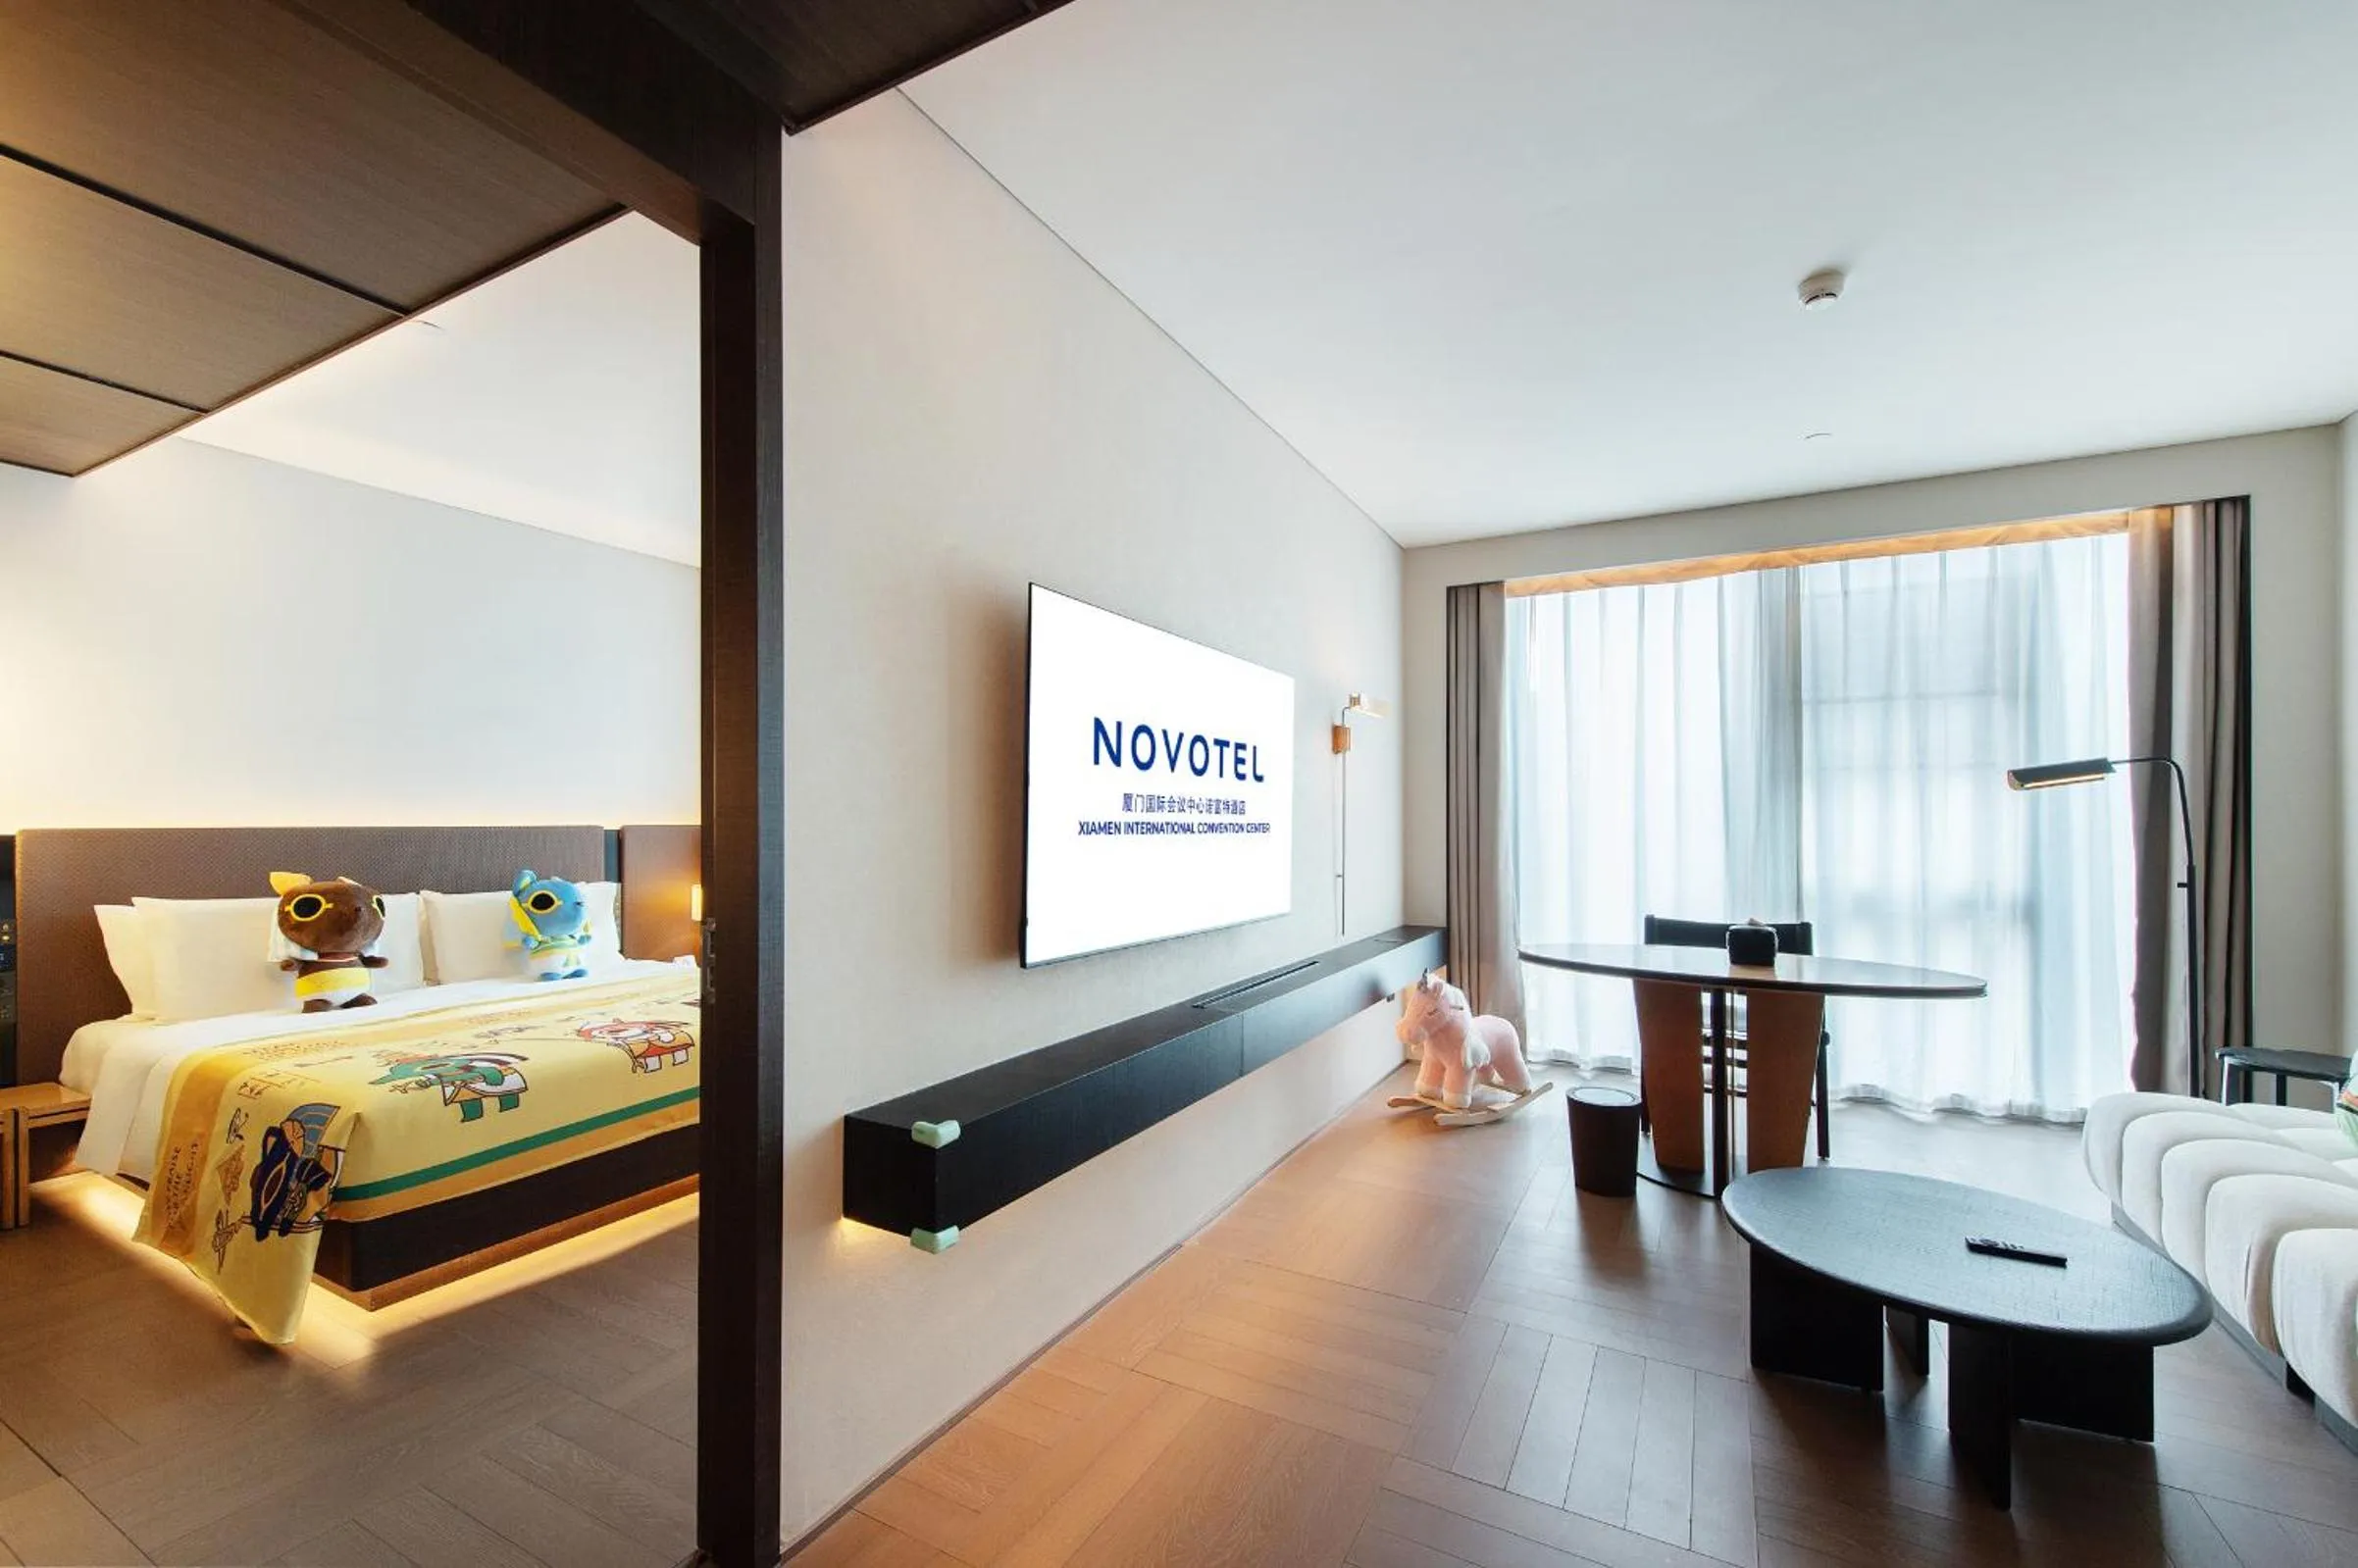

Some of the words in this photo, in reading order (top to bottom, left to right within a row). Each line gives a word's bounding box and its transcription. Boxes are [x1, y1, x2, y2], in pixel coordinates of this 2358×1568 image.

[1094, 717, 1264, 783] NOVOTEL
[1122, 793, 1246, 815] 厦门国际会议中心诺富特酒店
[1078, 821, 1121, 835] XIAMEN
[1124, 822, 1196, 835] INTERNATIONAL
[1197, 822, 1245, 835] CONVENTION
[1246, 823, 1270, 834] CENTER
